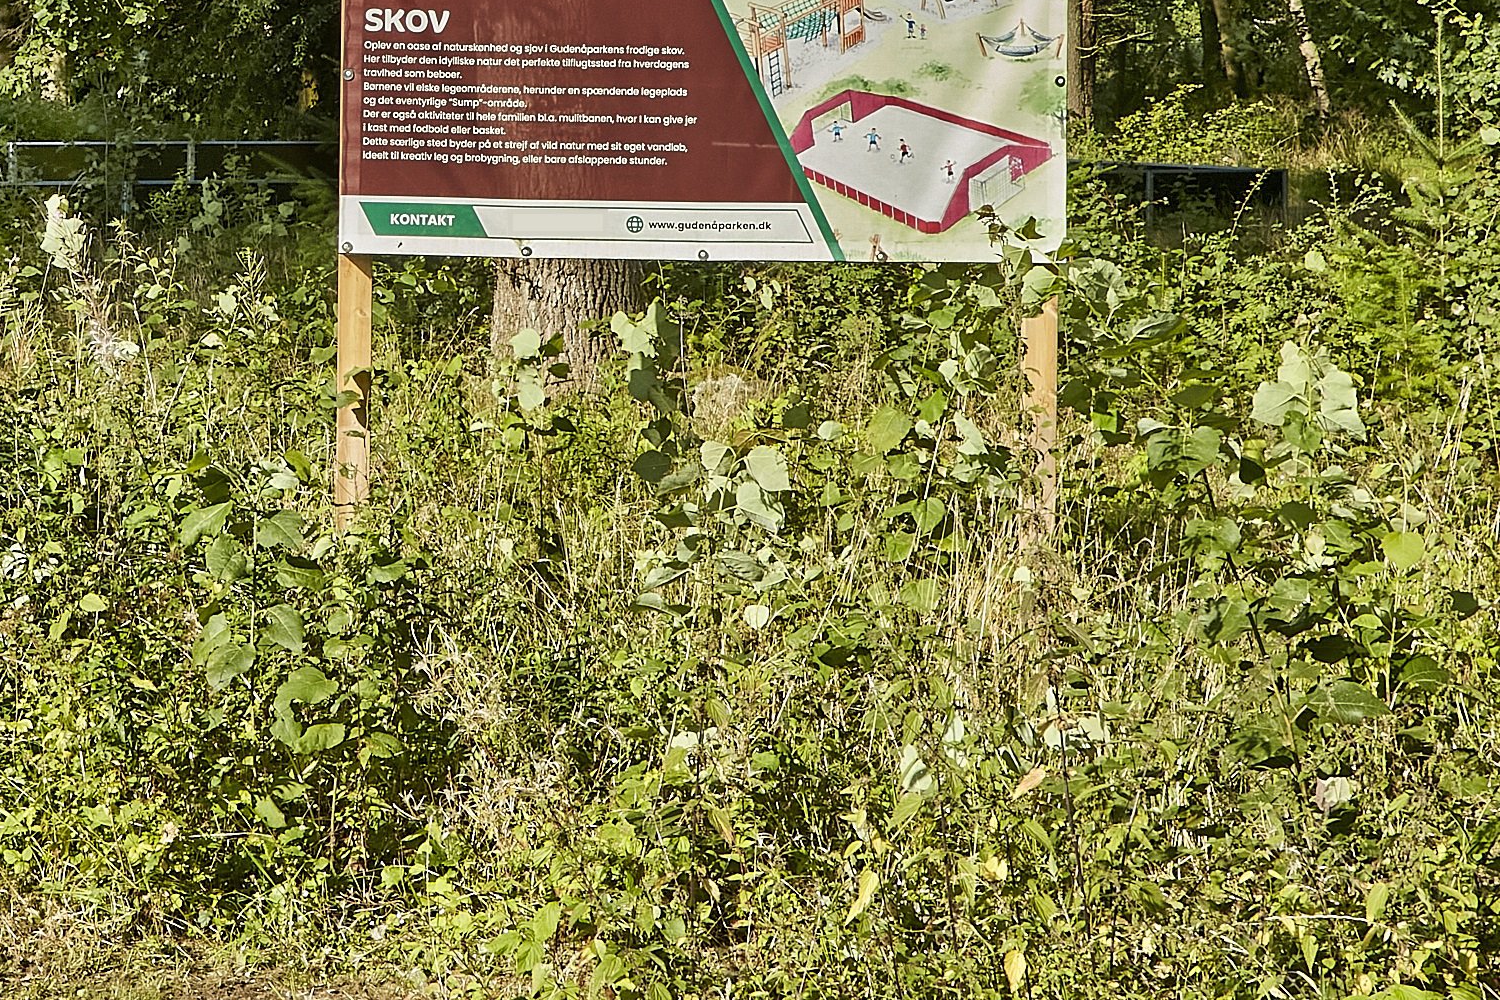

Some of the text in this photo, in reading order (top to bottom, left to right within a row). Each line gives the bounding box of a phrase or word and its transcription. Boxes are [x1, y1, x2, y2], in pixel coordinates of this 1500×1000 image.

[363, 8, 451, 34] SKOV
[364, 41, 391, 51] Oplev
[432, 42, 441, 50] af
[444, 43, 508, 52] naturskønhed
[510, 45, 522, 54] og
[626, 45, 659, 56] frodige
[662, 45, 684, 54] skov.
[364, 55, 380, 63] Her
[382, 55, 417, 65] tilbyder
[419, 56, 437, 64] den
[439, 56, 475, 67] idylliske
[504, 57, 520, 66] det
[522, 58, 560, 68] perfekte
[562, 58, 616, 69] tilflugtssted
[618, 59, 631, 67] fra
[633, 59, 689, 71] hverdagens
[364, 69, 402, 77] travlhed
[427, 70, 462, 79] beboer.
[364, 82, 402, 91] Børnene
[404, 83, 414, 91] vil
[416, 83, 440, 92] elske
[523, 85, 566, 94] herunder
[582, 87, 639, 97] spændende
[641, 87, 687, 98] legeplads
[363, 97, 376, 106] og
[378, 96, 393, 104] det
[395, 97, 447, 108] eventyrlige
[363, 110, 380, 118] Der
[393, 110, 416, 121] også
[418, 111, 464, 120] aktiviteter
[466, 112, 474, 120] til
[476, 112, 496, 121] hele
[498, 112, 535, 121] familien
[616, 114, 637, 123] hvor
[644, 115, 661, 123] kan
[663, 115, 683, 126] give
[685, 115, 697, 126] jer
[368, 123, 387, 132] kast
[389, 124, 411, 132] med
[413, 124, 449, 133] fodbold
[451, 126, 471, 134] eller
[473, 126, 506, 135] basket.
[363, 137, 388, 145] Dette
[390, 138, 425, 149] særlige
[427, 139, 447, 147] sted
[449, 139, 477, 150] byder
[479, 139, 491, 150] på
[505, 139, 528, 151] strejf
[529, 141, 539, 149] af
[541, 141, 558, 149] vild
[560, 142, 585, 150] natur
[587, 142, 609, 150] med
[611, 142, 622, 150] sit
[624, 143, 645, 153] eget
[391, 151, 399, 159] til
[401, 151, 432, 160] kreativ
[434, 152, 448, 163] leg
[450, 154, 463, 163] og
[522, 155, 542, 163] eller
[544, 155, 566, 163] bare
[568, 155, 627, 166] afslappende
[629, 157, 667, 165] stunder.
[389, 213, 455, 229] KONTAKT
[648, 220, 772, 232] www.gudenåparken.dk
